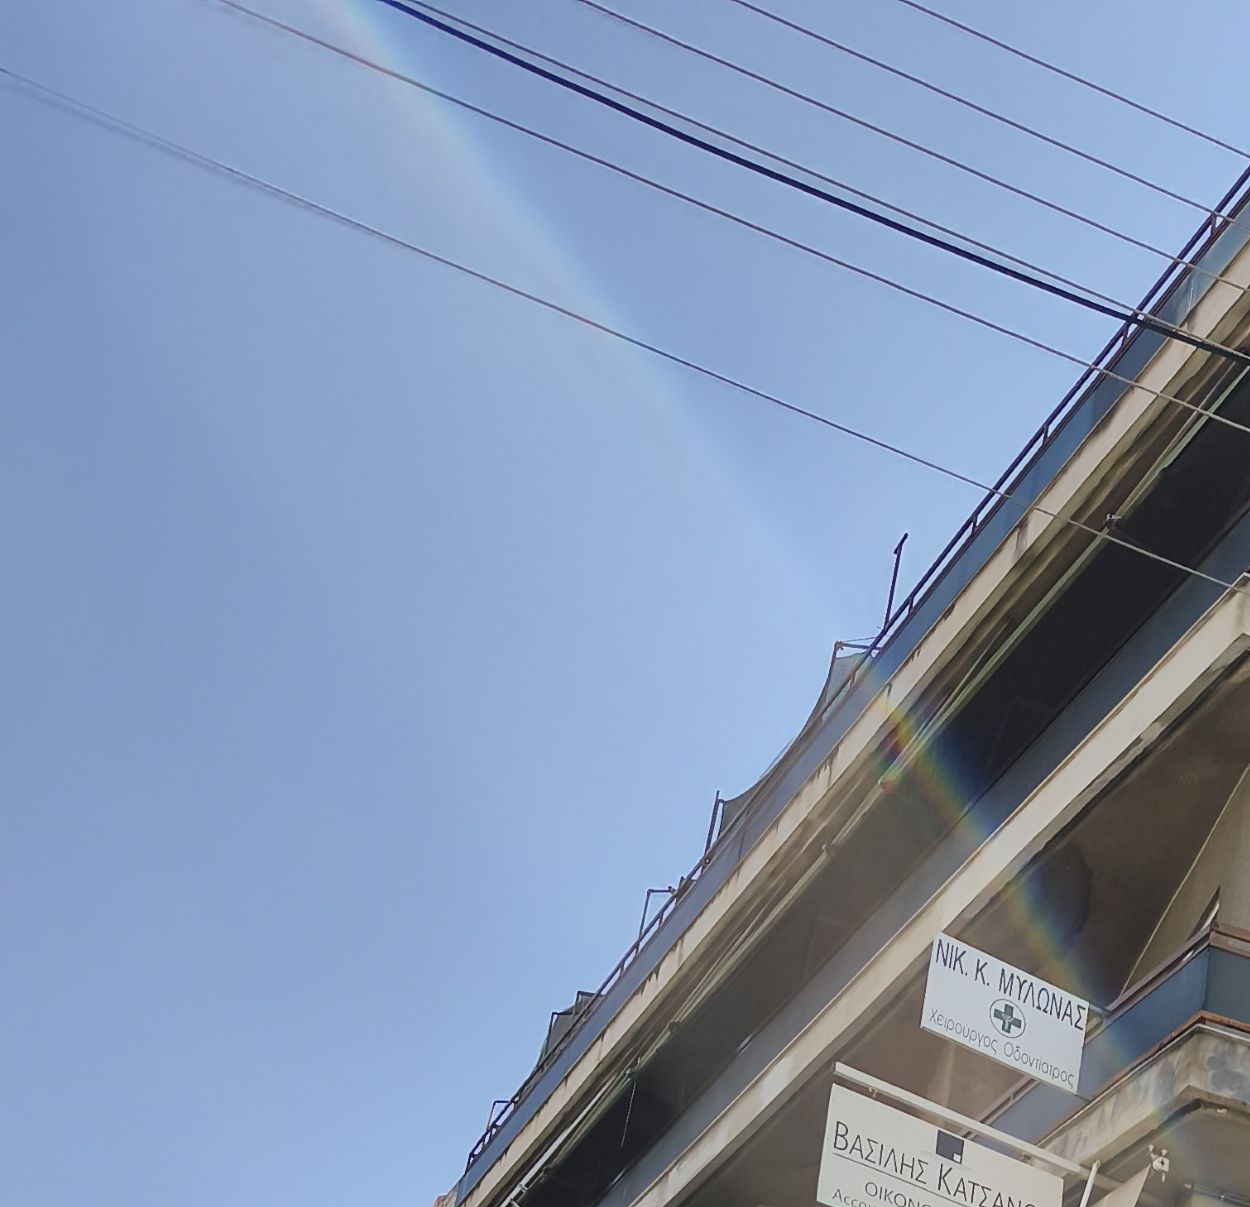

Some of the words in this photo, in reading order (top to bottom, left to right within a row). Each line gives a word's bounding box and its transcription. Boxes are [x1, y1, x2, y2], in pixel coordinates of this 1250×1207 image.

[935, 938, 969, 976] ΝΙΚ.
[974, 957, 990, 987] Κ.
[998, 967, 1085, 1031] ΜΥΛΩΝΑΣ
[833, 1120, 928, 1185] ΒΑΣΙΛΗΣ
